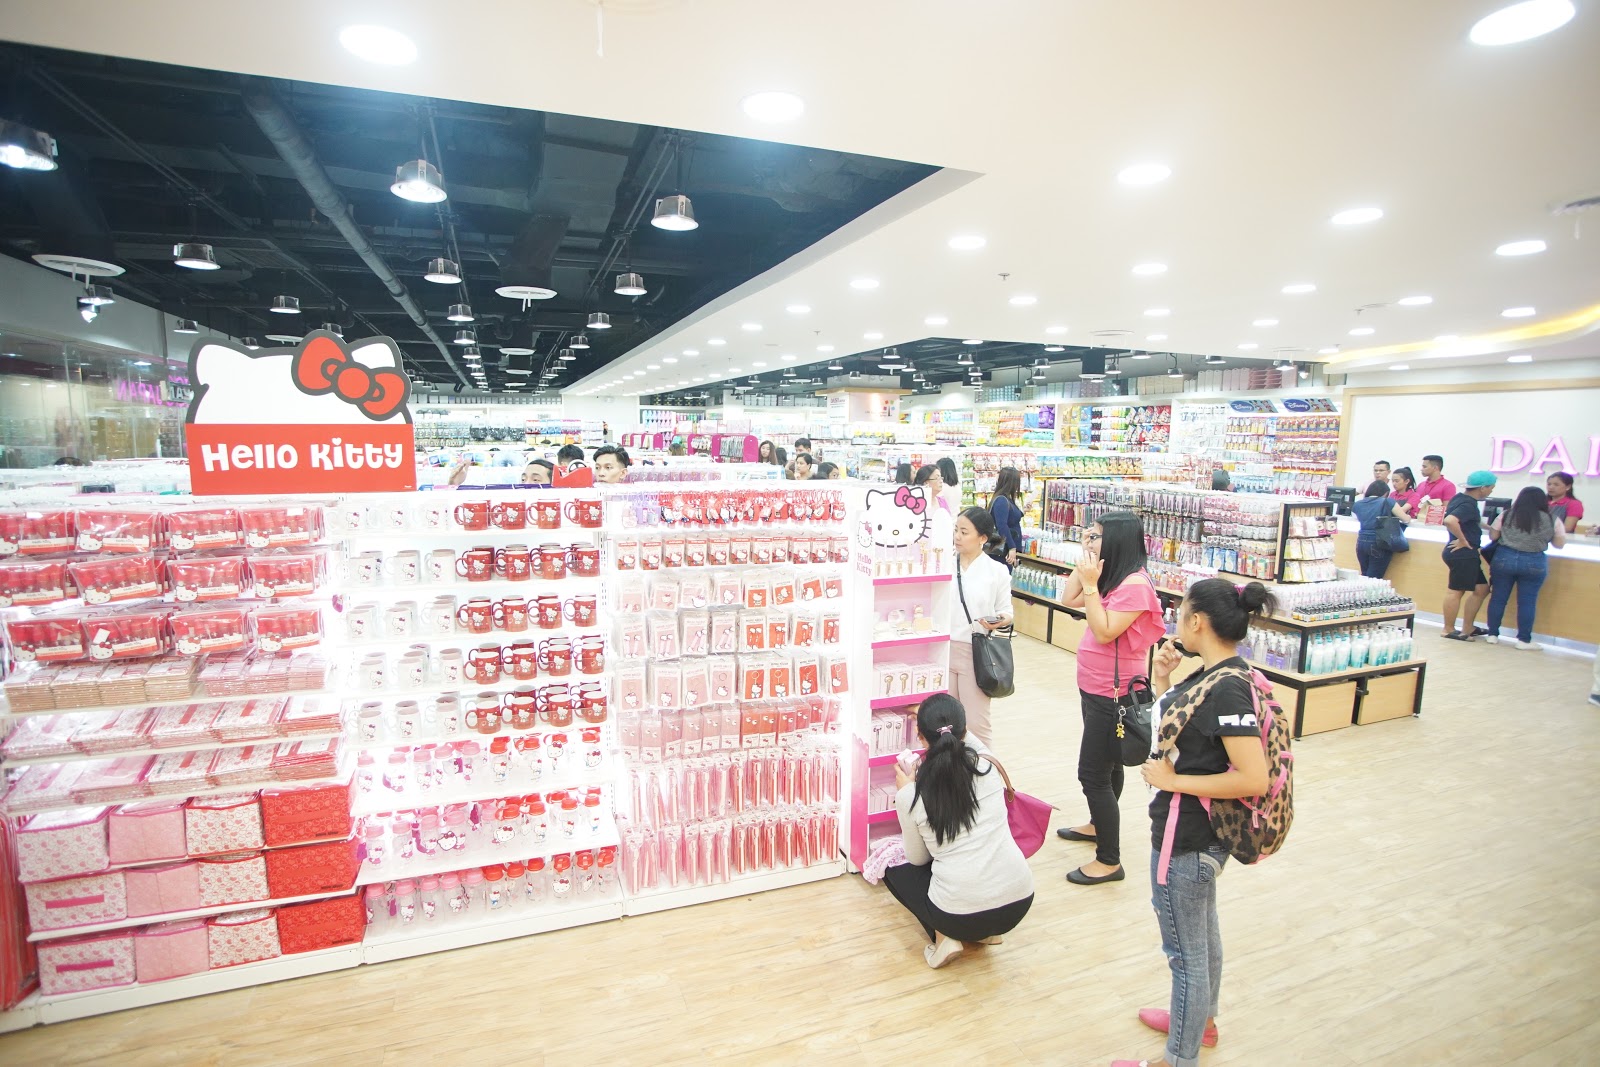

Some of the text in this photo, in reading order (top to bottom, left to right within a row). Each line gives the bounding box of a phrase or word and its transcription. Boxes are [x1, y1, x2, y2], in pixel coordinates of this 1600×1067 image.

[201, 437, 403, 472] Hello Kitty
[1489, 435, 1600, 477] DAI
[856, 561, 873, 576] Kitty
[857, 552, 872, 565] Hello
